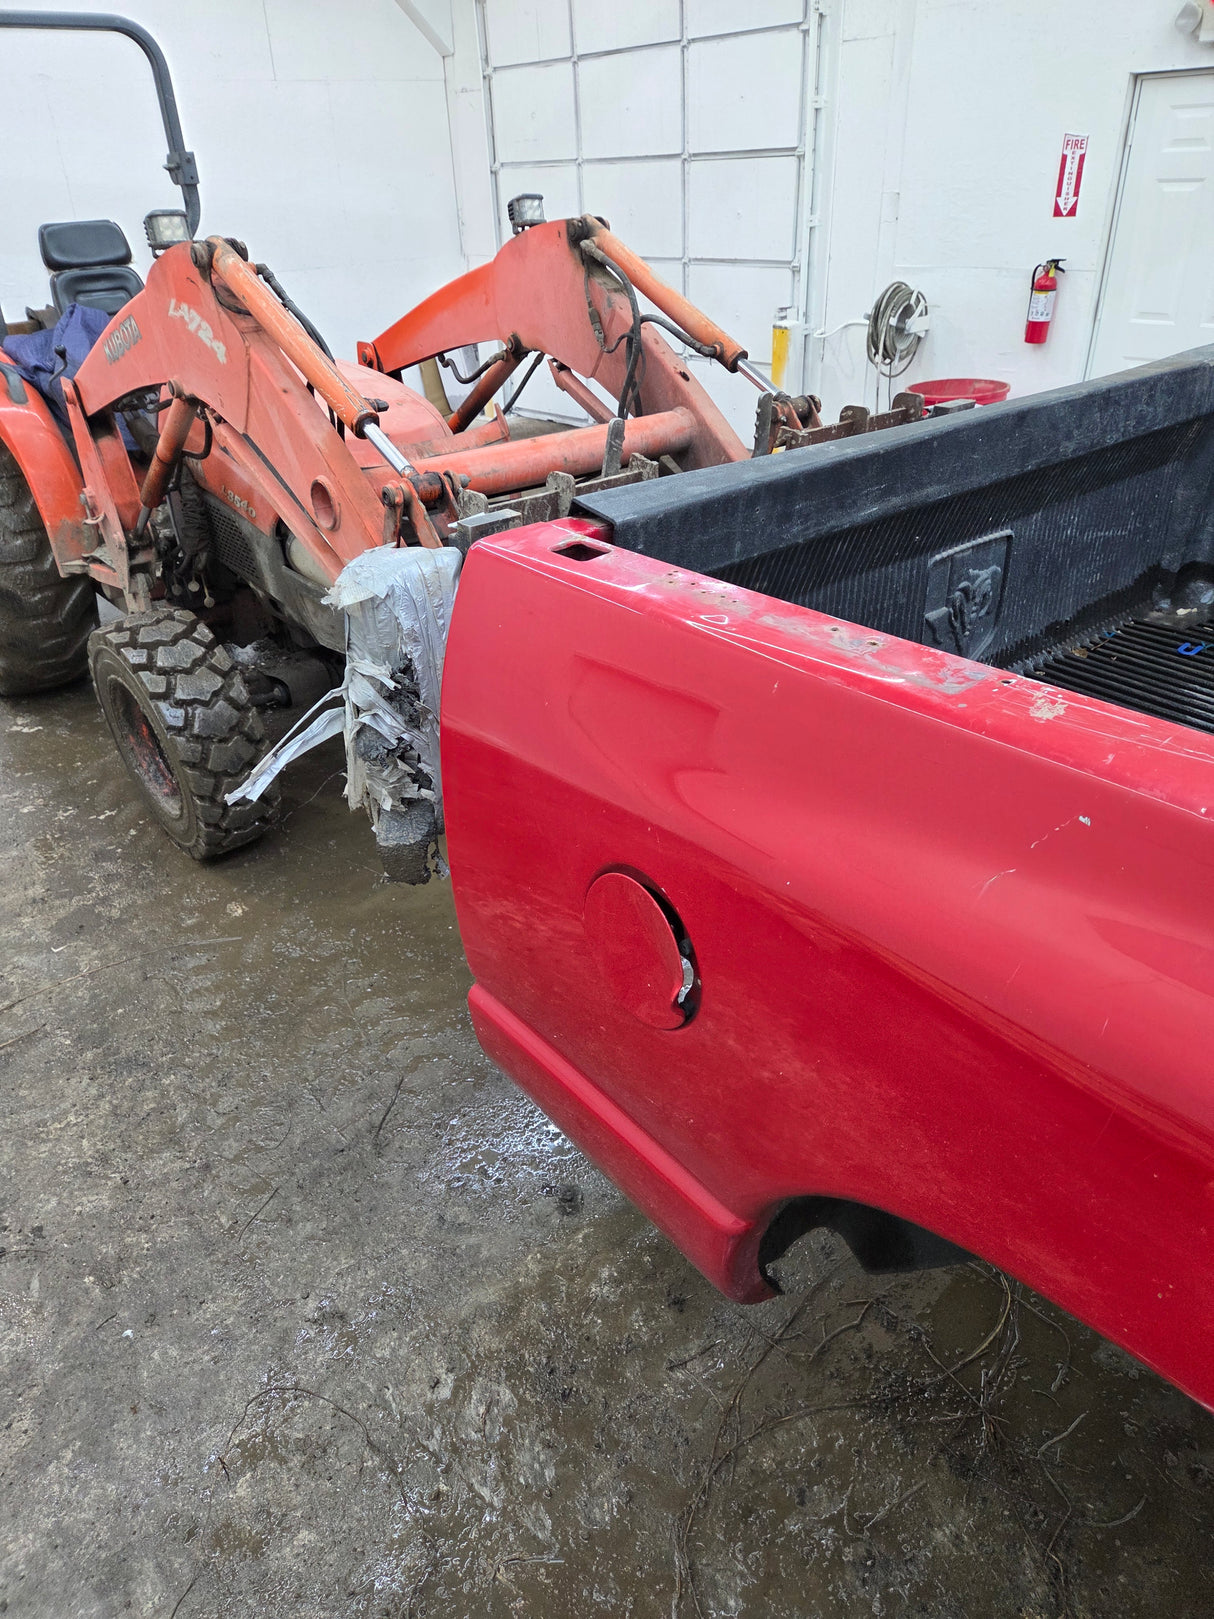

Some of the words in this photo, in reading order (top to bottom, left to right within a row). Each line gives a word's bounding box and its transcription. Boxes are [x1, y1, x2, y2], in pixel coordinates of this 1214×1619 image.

[1065, 139, 1086, 150] FIRE
[1063, 150, 1077, 211] EXTINGUISHER
[103, 313, 142, 365] KUBOTA
[168, 298, 227, 364] LA724
